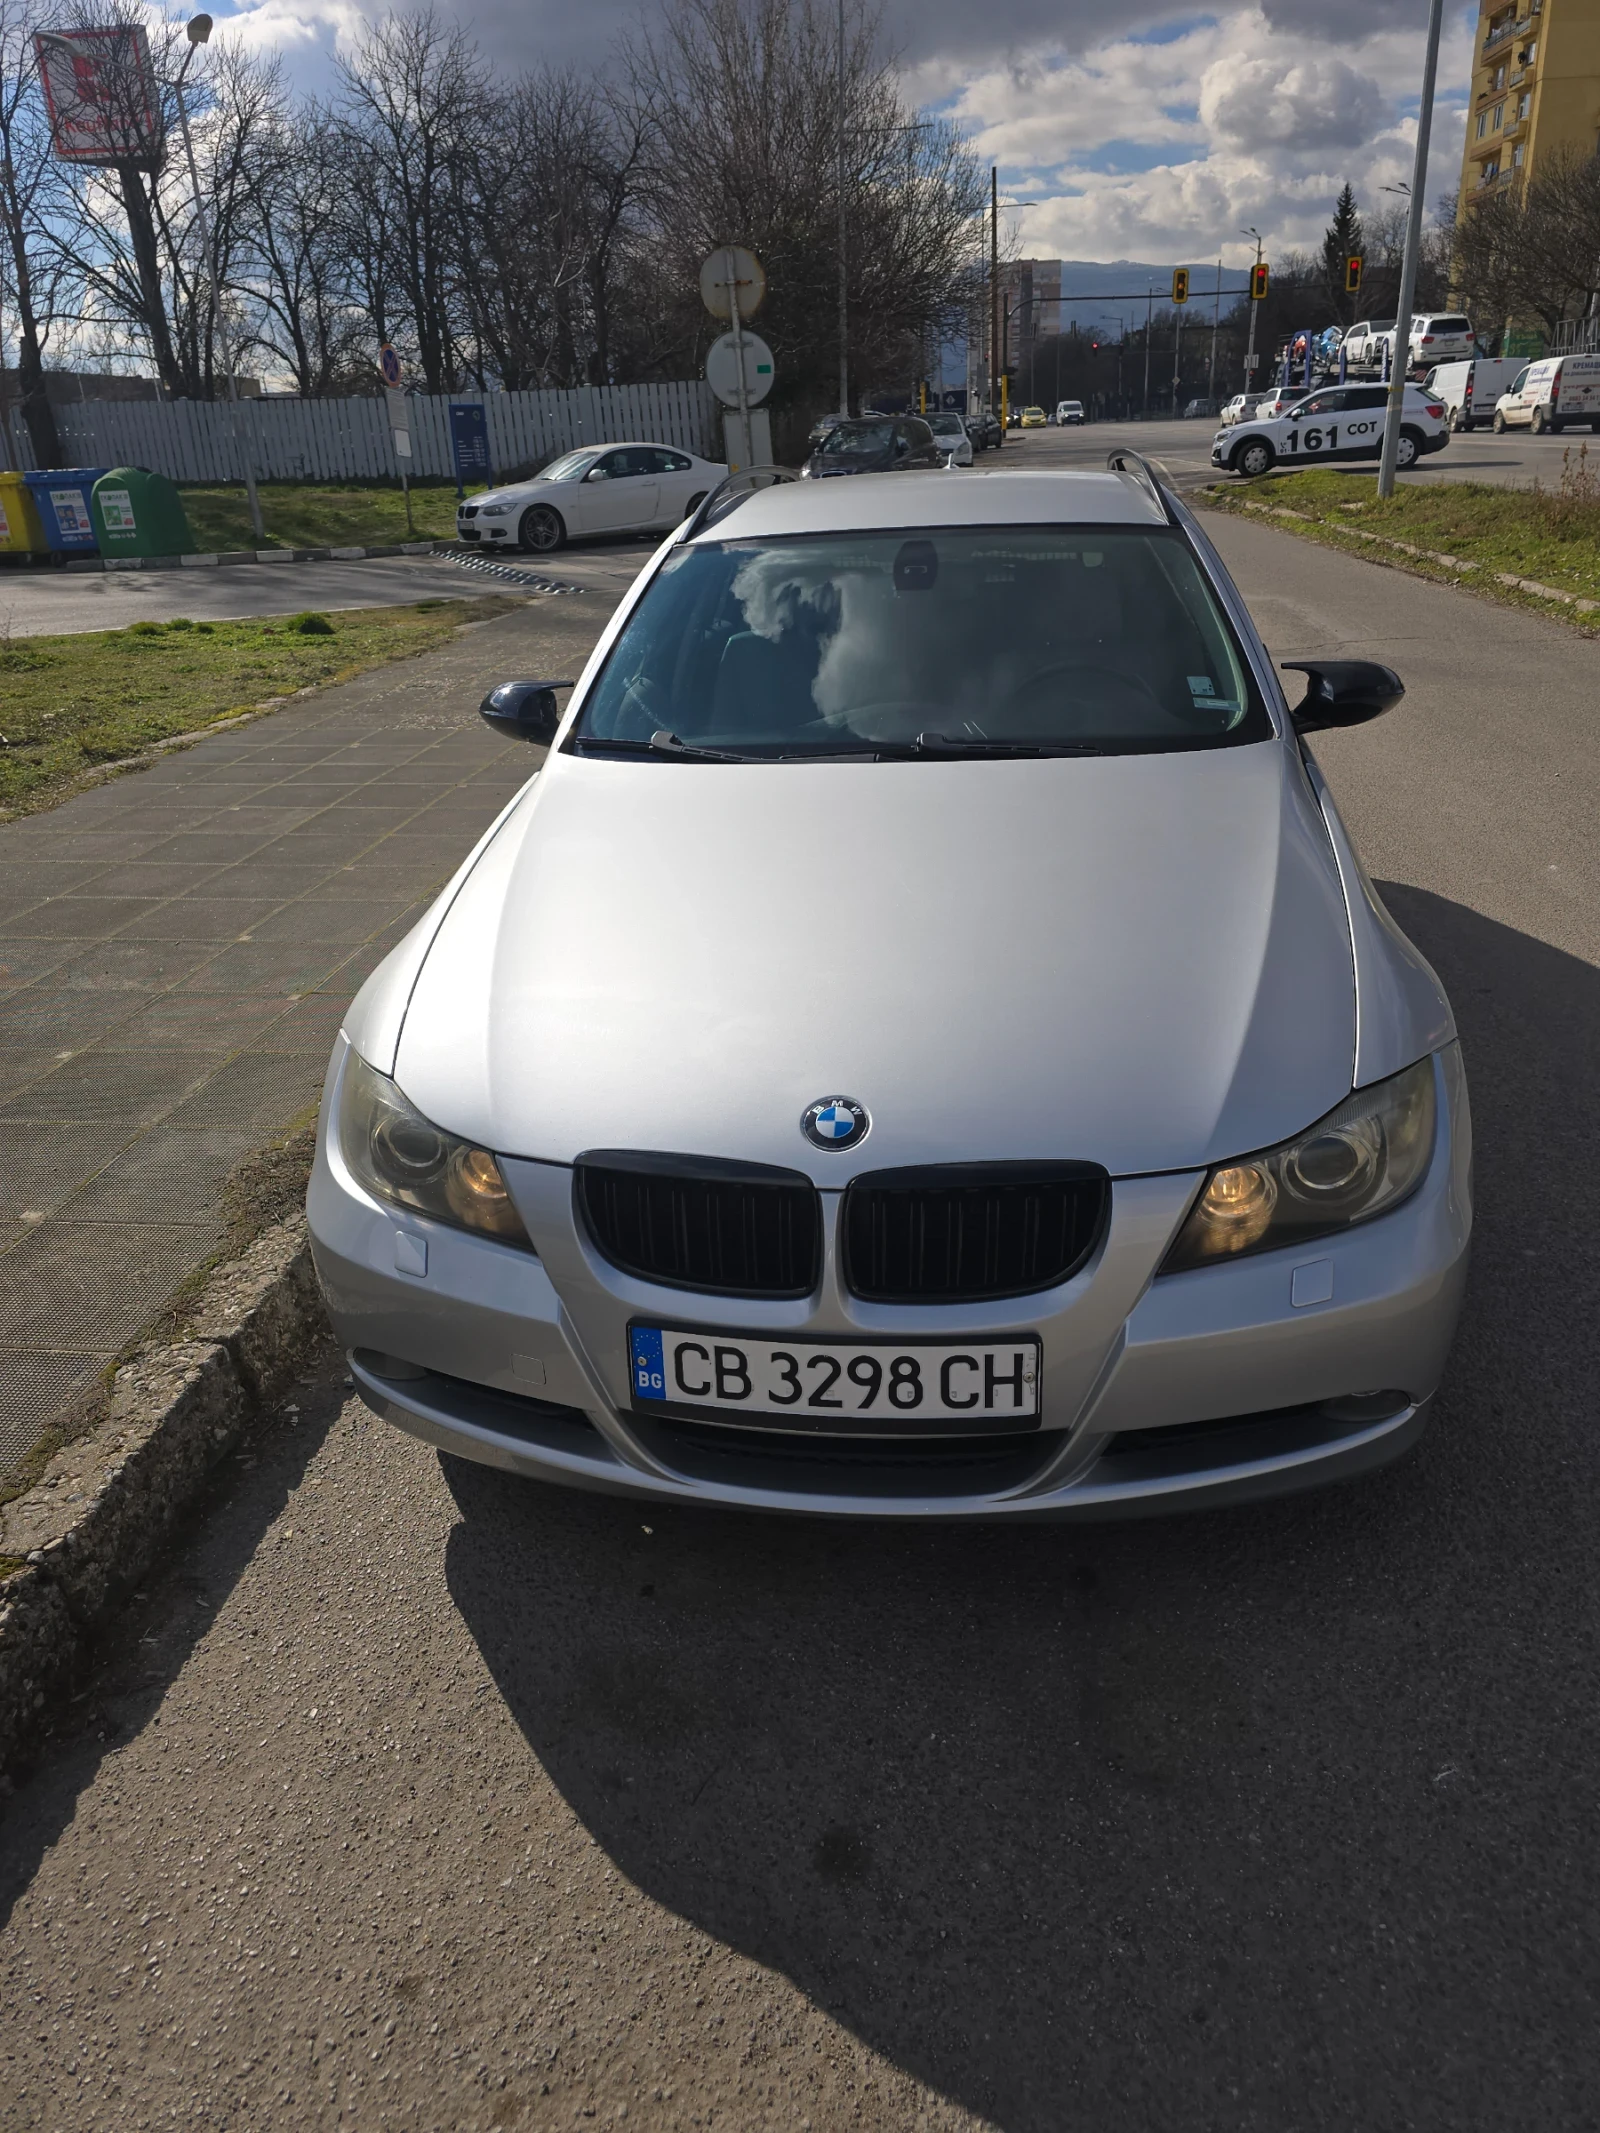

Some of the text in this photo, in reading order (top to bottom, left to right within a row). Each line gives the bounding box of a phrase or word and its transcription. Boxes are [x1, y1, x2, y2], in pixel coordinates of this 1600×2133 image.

[1287, 425, 1338, 453] 161
[812, 1099, 863, 1116] BMW
[638, 1370, 662, 1390] BG
[767, 1350, 924, 1410] 3298
